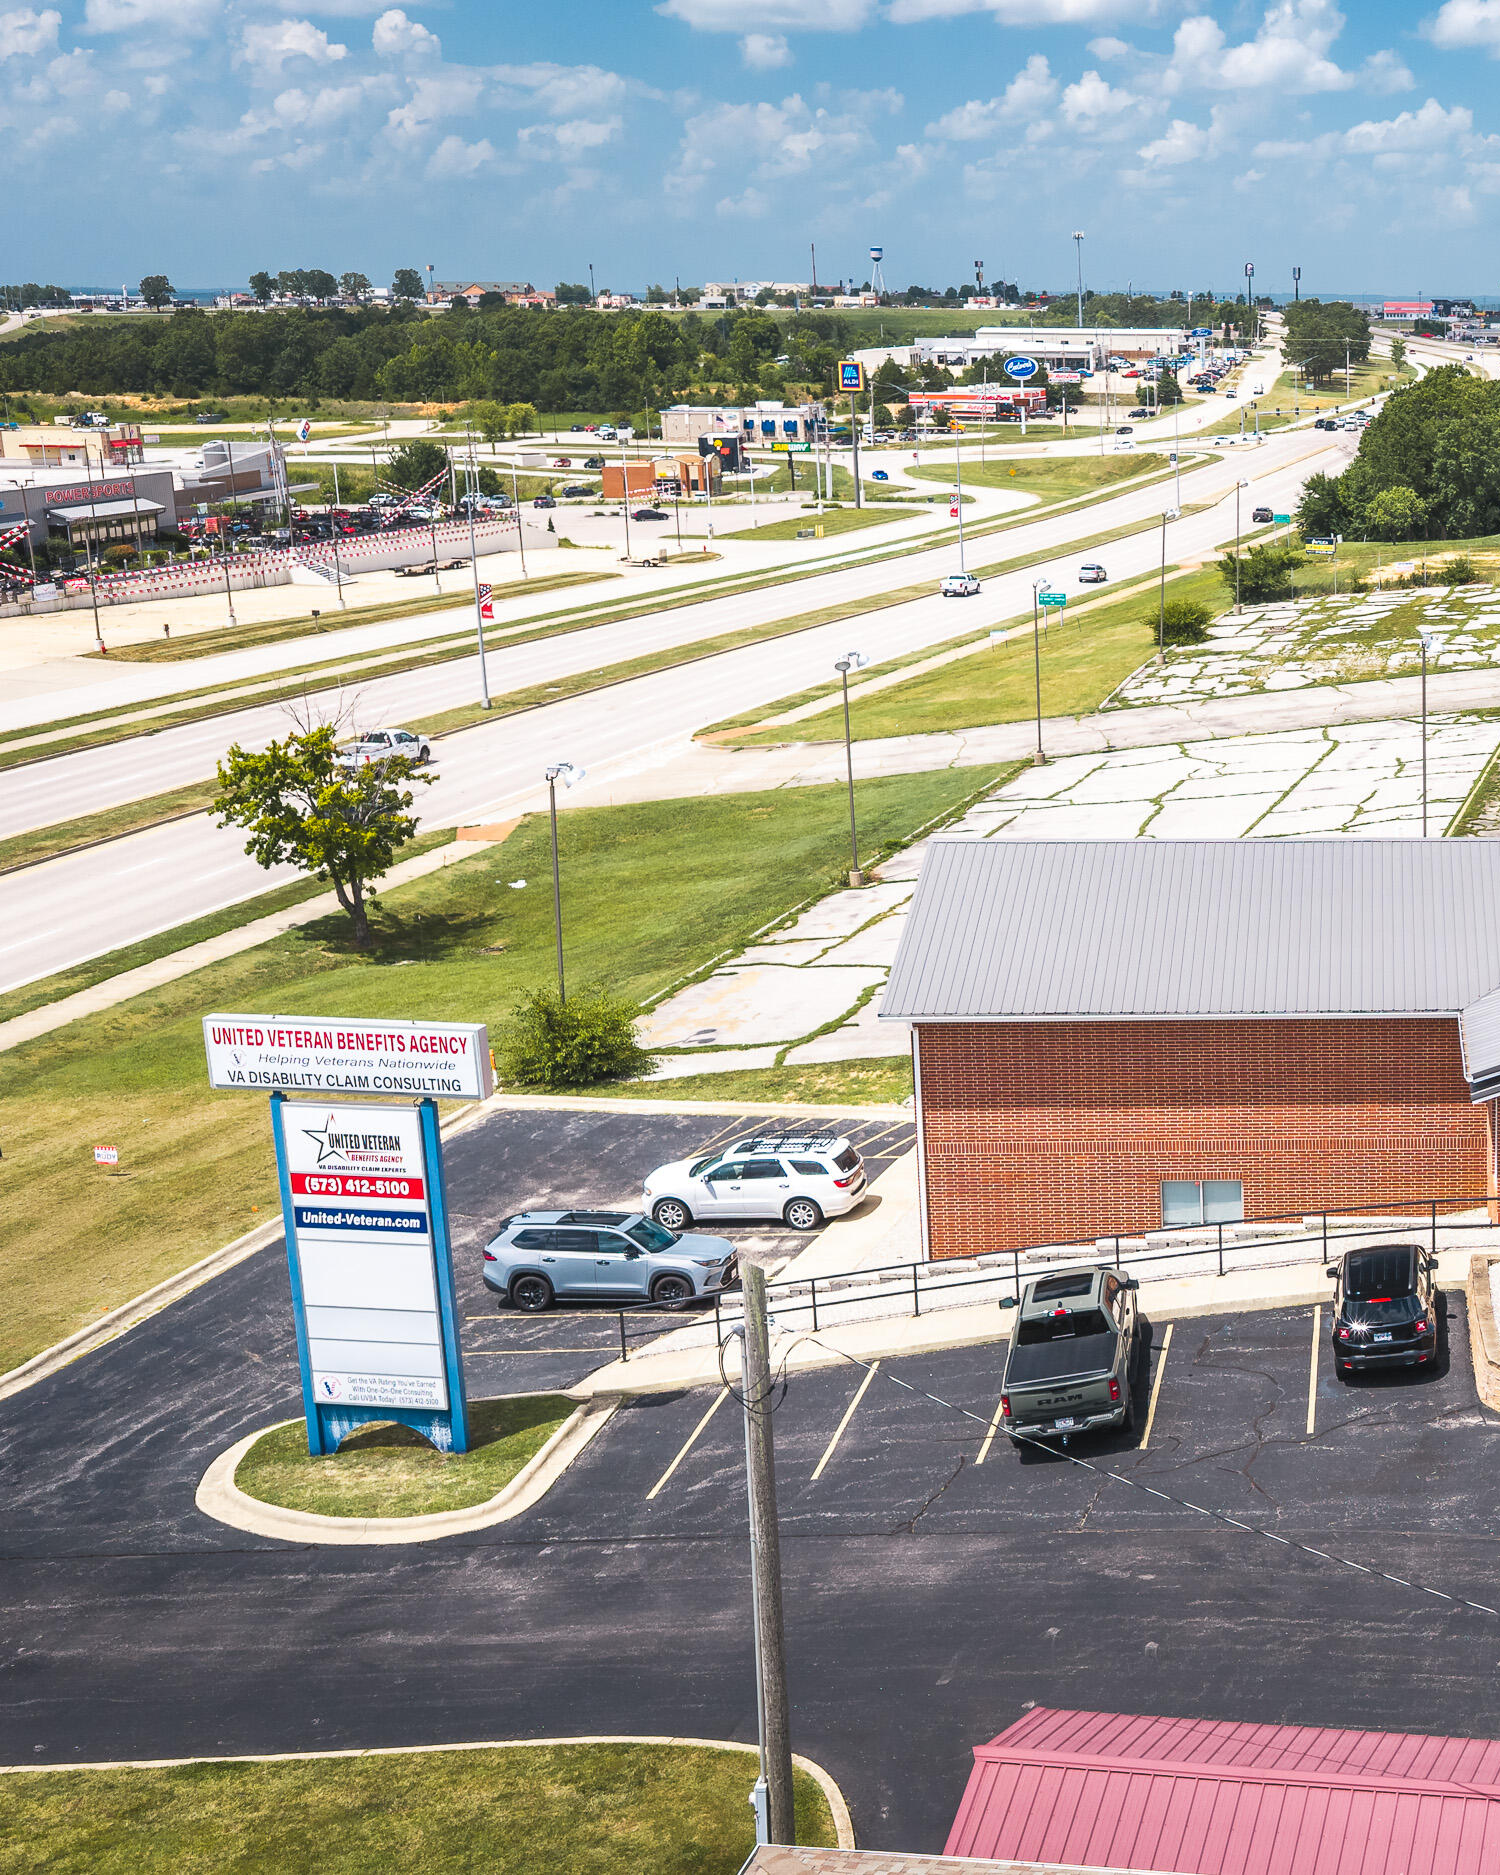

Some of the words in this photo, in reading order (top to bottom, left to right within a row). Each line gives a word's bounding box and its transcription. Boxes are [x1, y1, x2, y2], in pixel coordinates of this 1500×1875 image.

[772, 443, 809, 451] SUBWAY
[212, 1027, 264, 1047] UNITED
[267, 1029, 334, 1050] VETERAN
[337, 1032, 406, 1052] BENEFITS
[409, 1035, 467, 1055] AGENCY
[258, 1053, 310, 1067] Helping
[315, 1056, 374, 1068] Veterans
[378, 1058, 456, 1071] Nationwide
[227, 1070, 246, 1083] VA
[249, 1071, 322, 1088] DISABILITY
[326, 1074, 369, 1089] CLAIM
[373, 1076, 461, 1092] CONSULTING
[328, 1133, 360, 1149] UNITED
[361, 1135, 401, 1151] VETERAN
[351, 1154, 379, 1163] BENEFITS
[379, 1155, 404, 1164] AGENCY
[304, 1176, 343, 1194] (573)
[345, 1179, 410, 1195] 412-5100
[302, 1211, 420, 1228] United-Veteran.com
[347, 1376, 358, 1384] Get
[416, 1380, 436, 1388] Earned
[348, 1393, 359, 1401] Call
[352, 1385, 366, 1393] With
[403, 1388, 433, 1398] Consulting
[1038, 1394, 1083, 1406] RAM
